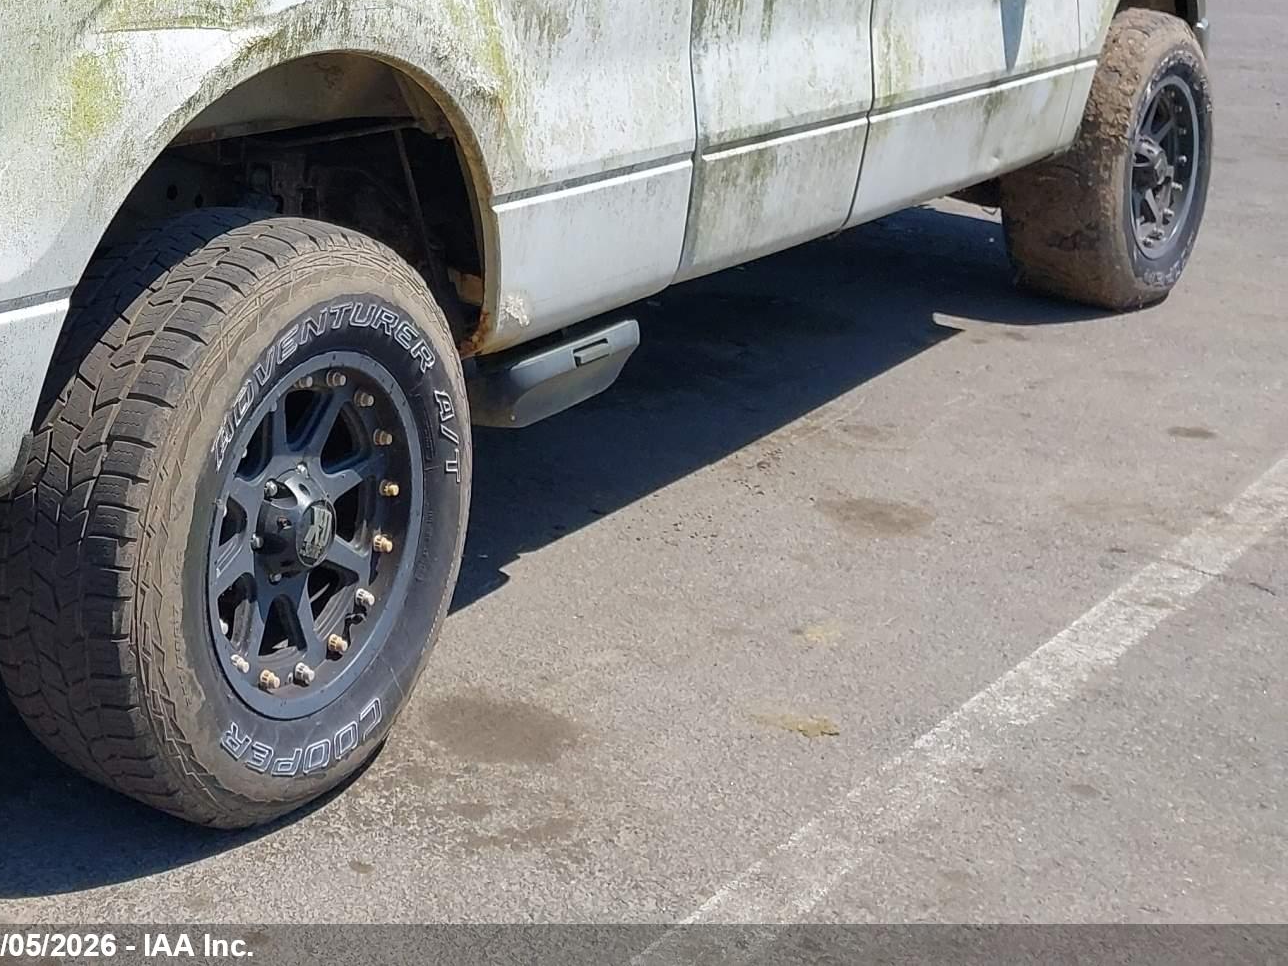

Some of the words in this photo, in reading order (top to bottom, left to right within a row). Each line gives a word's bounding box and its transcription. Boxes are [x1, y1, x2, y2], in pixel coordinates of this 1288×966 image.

[210, 302, 436, 474] ADVENTURER
[433, 389, 461, 483] A/T
[220, 697, 382, 777] COOPER
